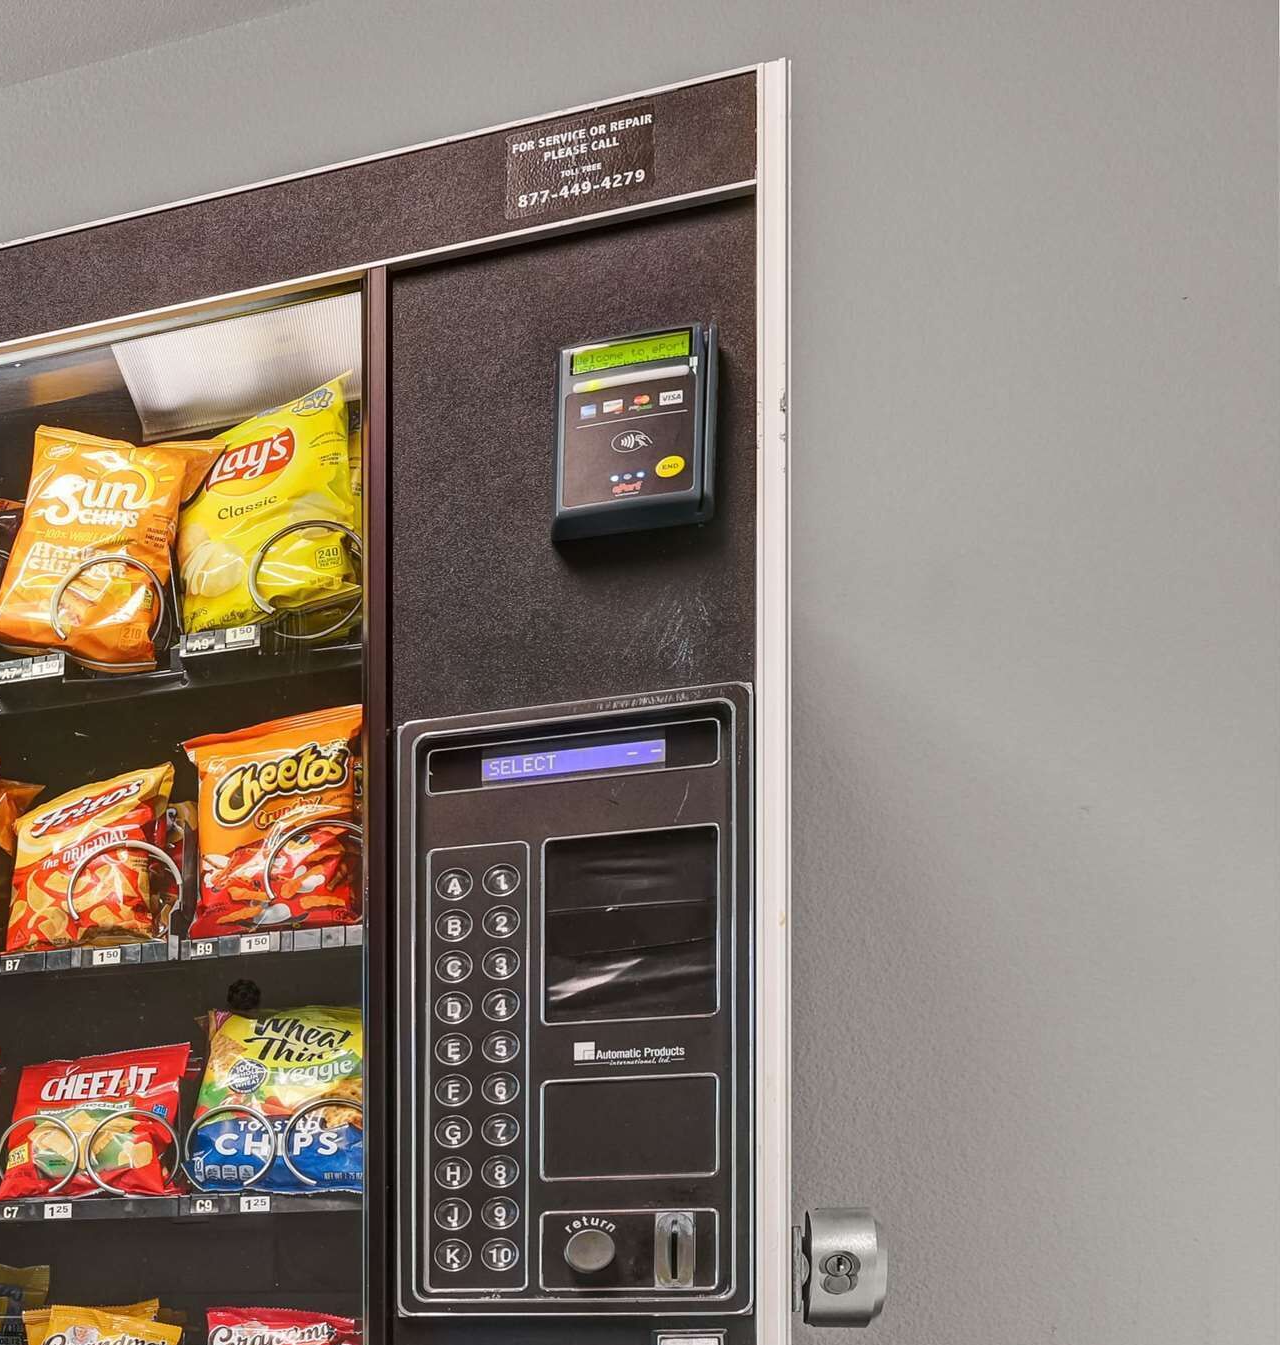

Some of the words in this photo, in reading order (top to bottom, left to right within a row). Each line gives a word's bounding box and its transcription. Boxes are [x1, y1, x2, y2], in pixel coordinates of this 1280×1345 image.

[512, 140, 535, 154] FOR
[538, 129, 586, 148] SERVICE
[590, 125, 606, 135] OR
[610, 114, 652, 132] REPAIR
[544, 145, 587, 162] PLEASE
[591, 137, 620, 151] CALL
[561, 168, 578, 178] TOLL
[581, 162, 602, 173] FREE
[518, 169, 645, 208] 877-449-4279
[631, 347, 645, 357] to
[652, 339, 686, 355] ePort
[663, 393, 682, 401] VISA
[208, 432, 293, 489] Lay's
[662, 462, 679, 471] END
[217, 495, 278, 520] Classic
[318, 548, 339, 559] 240
[192, 639, 209, 652] A9
[489, 755, 556, 776] SELECT
[214, 741, 349, 827] Cheetos
[31, 779, 144, 838] Fritos
[42, 858, 59, 871] The
[447, 878, 462, 894] A
[496, 874, 507, 890] 1
[447, 919, 462, 935] B
[495, 915, 508, 931] 2
[197, 943, 213, 955] B9
[6, 960, 20, 971] B7
[447, 960, 462, 976] C
[495, 956, 508, 973] 3
[447, 1001, 461, 1018] D
[494, 998, 507, 1015] 4
[253, 1016, 353, 1047] Wheat
[447, 1043, 460, 1059] E
[495, 1040, 507, 1056] 5
[596, 1047, 641, 1060] Automatic
[644, 1046, 685, 1057] Products
[448, 1083, 460, 1100] F
[494, 1081, 506, 1098] 6
[445, 1124, 461, 1141] G
[495, 1123, 506, 1139] 7
[215, 1132, 337, 1156] CHIPS
[446, 1166, 461, 1182] H
[494, 1164, 506, 1181] 8
[196, 1199, 212, 1212] C9
[447, 1207, 459, 1224] J
[494, 1206, 506, 1222] 9
[564, 1216, 617, 1234] return
[446, 1249, 460, 1264] K
[488, 1248, 510, 1264] 10
